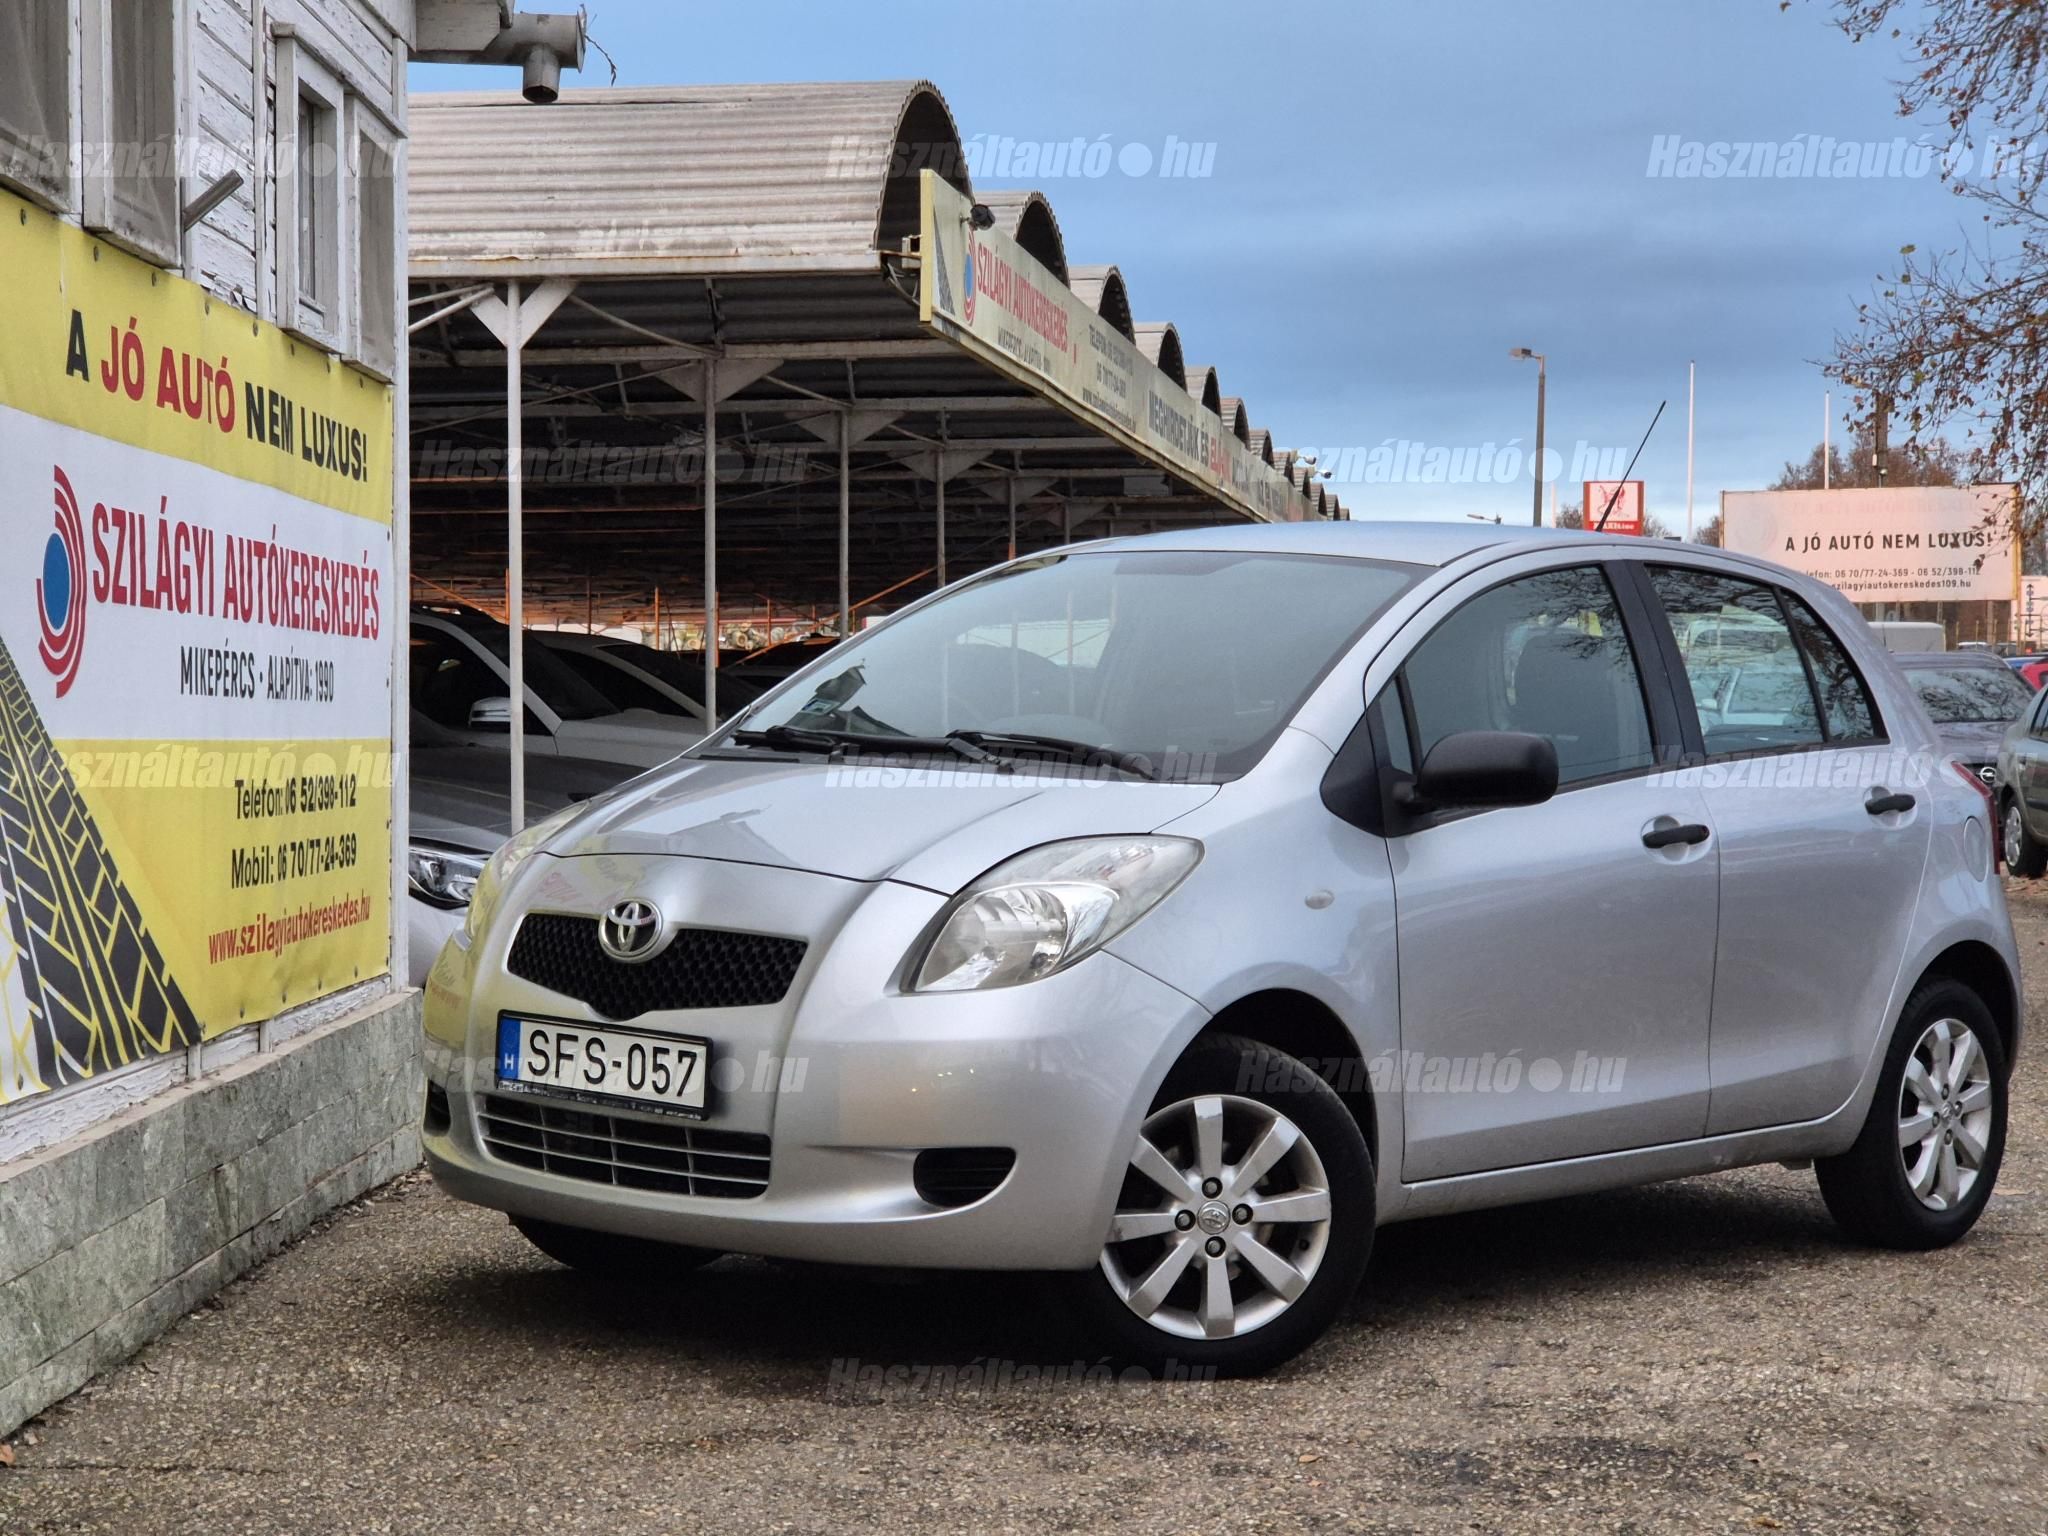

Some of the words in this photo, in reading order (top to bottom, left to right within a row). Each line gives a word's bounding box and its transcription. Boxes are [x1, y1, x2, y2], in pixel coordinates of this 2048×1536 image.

[66, 309, 89, 382] A
[101, 317, 145, 401] JÓ
[156, 346, 236, 433] AUTÓ
[245, 381, 294, 455] NEM
[301, 406, 368, 482] LUXUS!
[92, 495, 214, 617] SZILÁGYI
[222, 524, 380, 640] AUTÓKERESKEDÉS
[1785, 537, 1795, 551] A
[1802, 531, 1821, 553] JÓ
[1829, 531, 1873, 550] AUTÓ
[1882, 534, 1919, 549] NEM
[1928, 532, 1991, 548] LUXUS!
[1807, 570, 1832, 578] lefon:
[1832, 579, 1971, 591] szilagyiautokereskedes109.hu
[180, 638, 255, 699] MIKEPÉRCS
[267, 645, 313, 702] ALAPÍTVA:
[315, 660, 334, 703] 1990
[235, 777, 283, 819] Telefon:
[285, 778, 296, 816] 06
[300, 773, 356, 814] 52/398-112
[231, 845, 274, 889] Mobil:
[278, 844, 287, 882] 06
[290, 833, 357, 879] 70/77-24-369
[209, 889, 371, 965] www.szilagyiautokereskedes.hu
[504, 1053, 515, 1070] H
[527, 1029, 698, 1098] SFS-057
